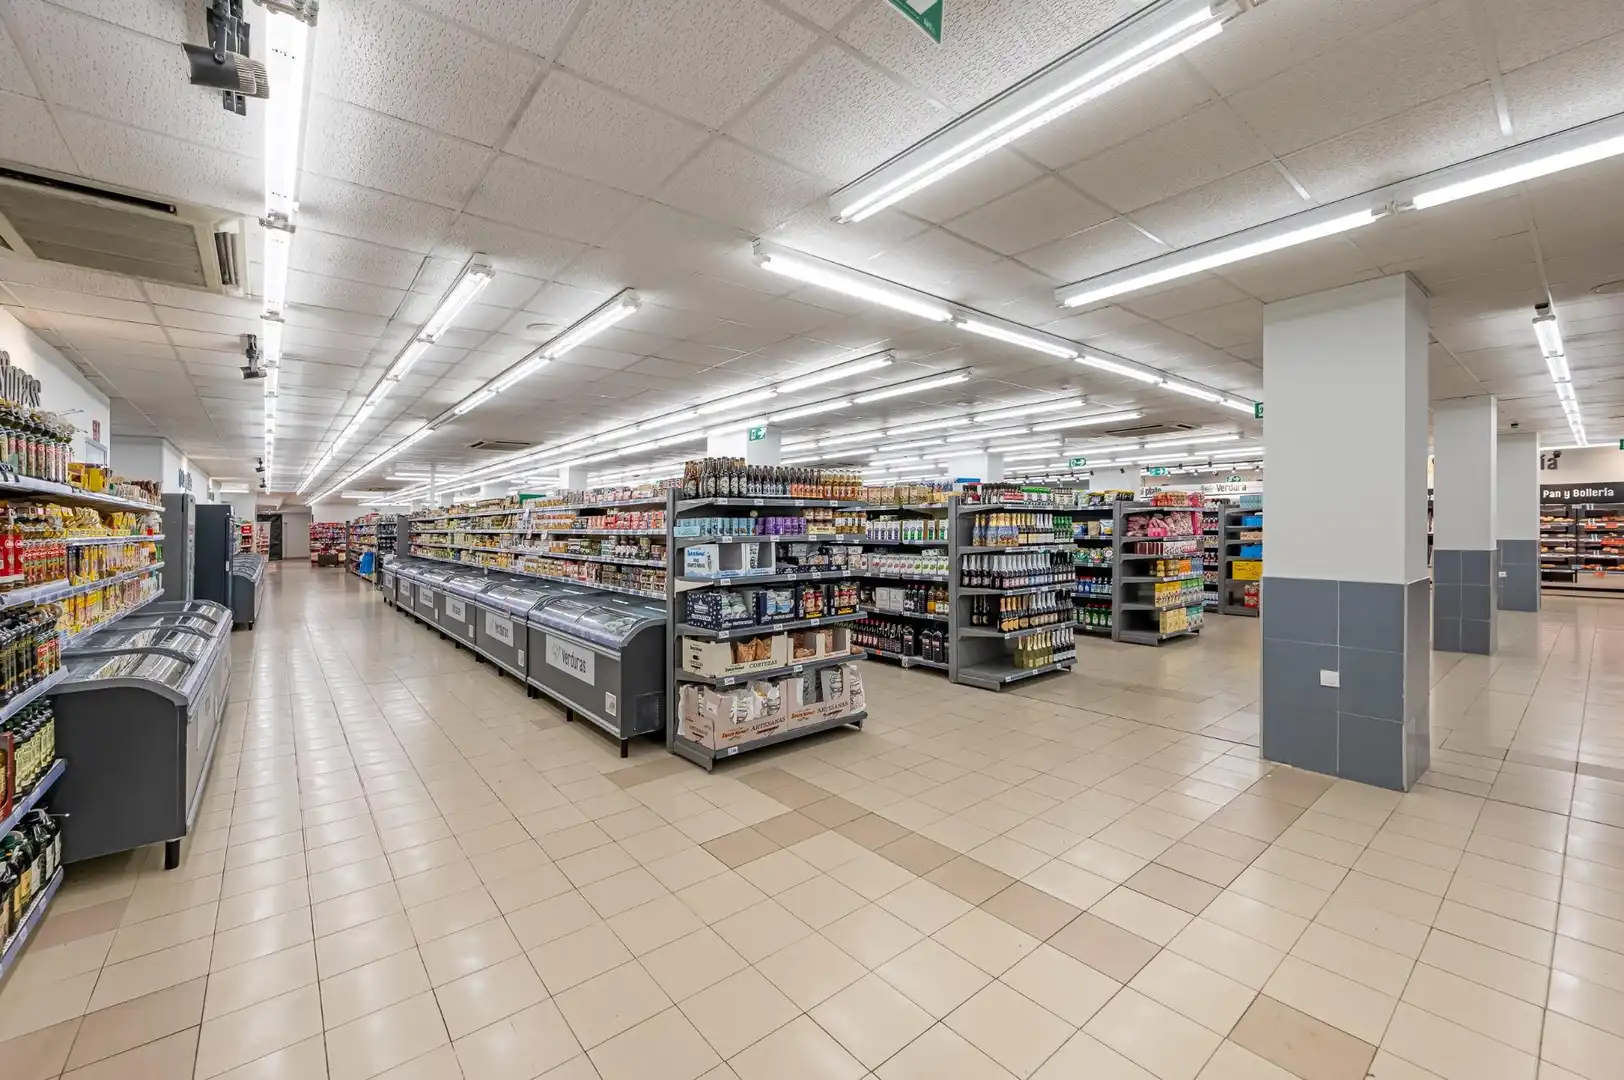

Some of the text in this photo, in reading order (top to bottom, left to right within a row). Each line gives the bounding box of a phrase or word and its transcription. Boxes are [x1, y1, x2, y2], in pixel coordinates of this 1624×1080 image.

[1543, 487, 1614, 499] Pan y Bollería
[561, 647, 587, 673] Verduras
[750, 716, 786, 732] ARTESANAS
